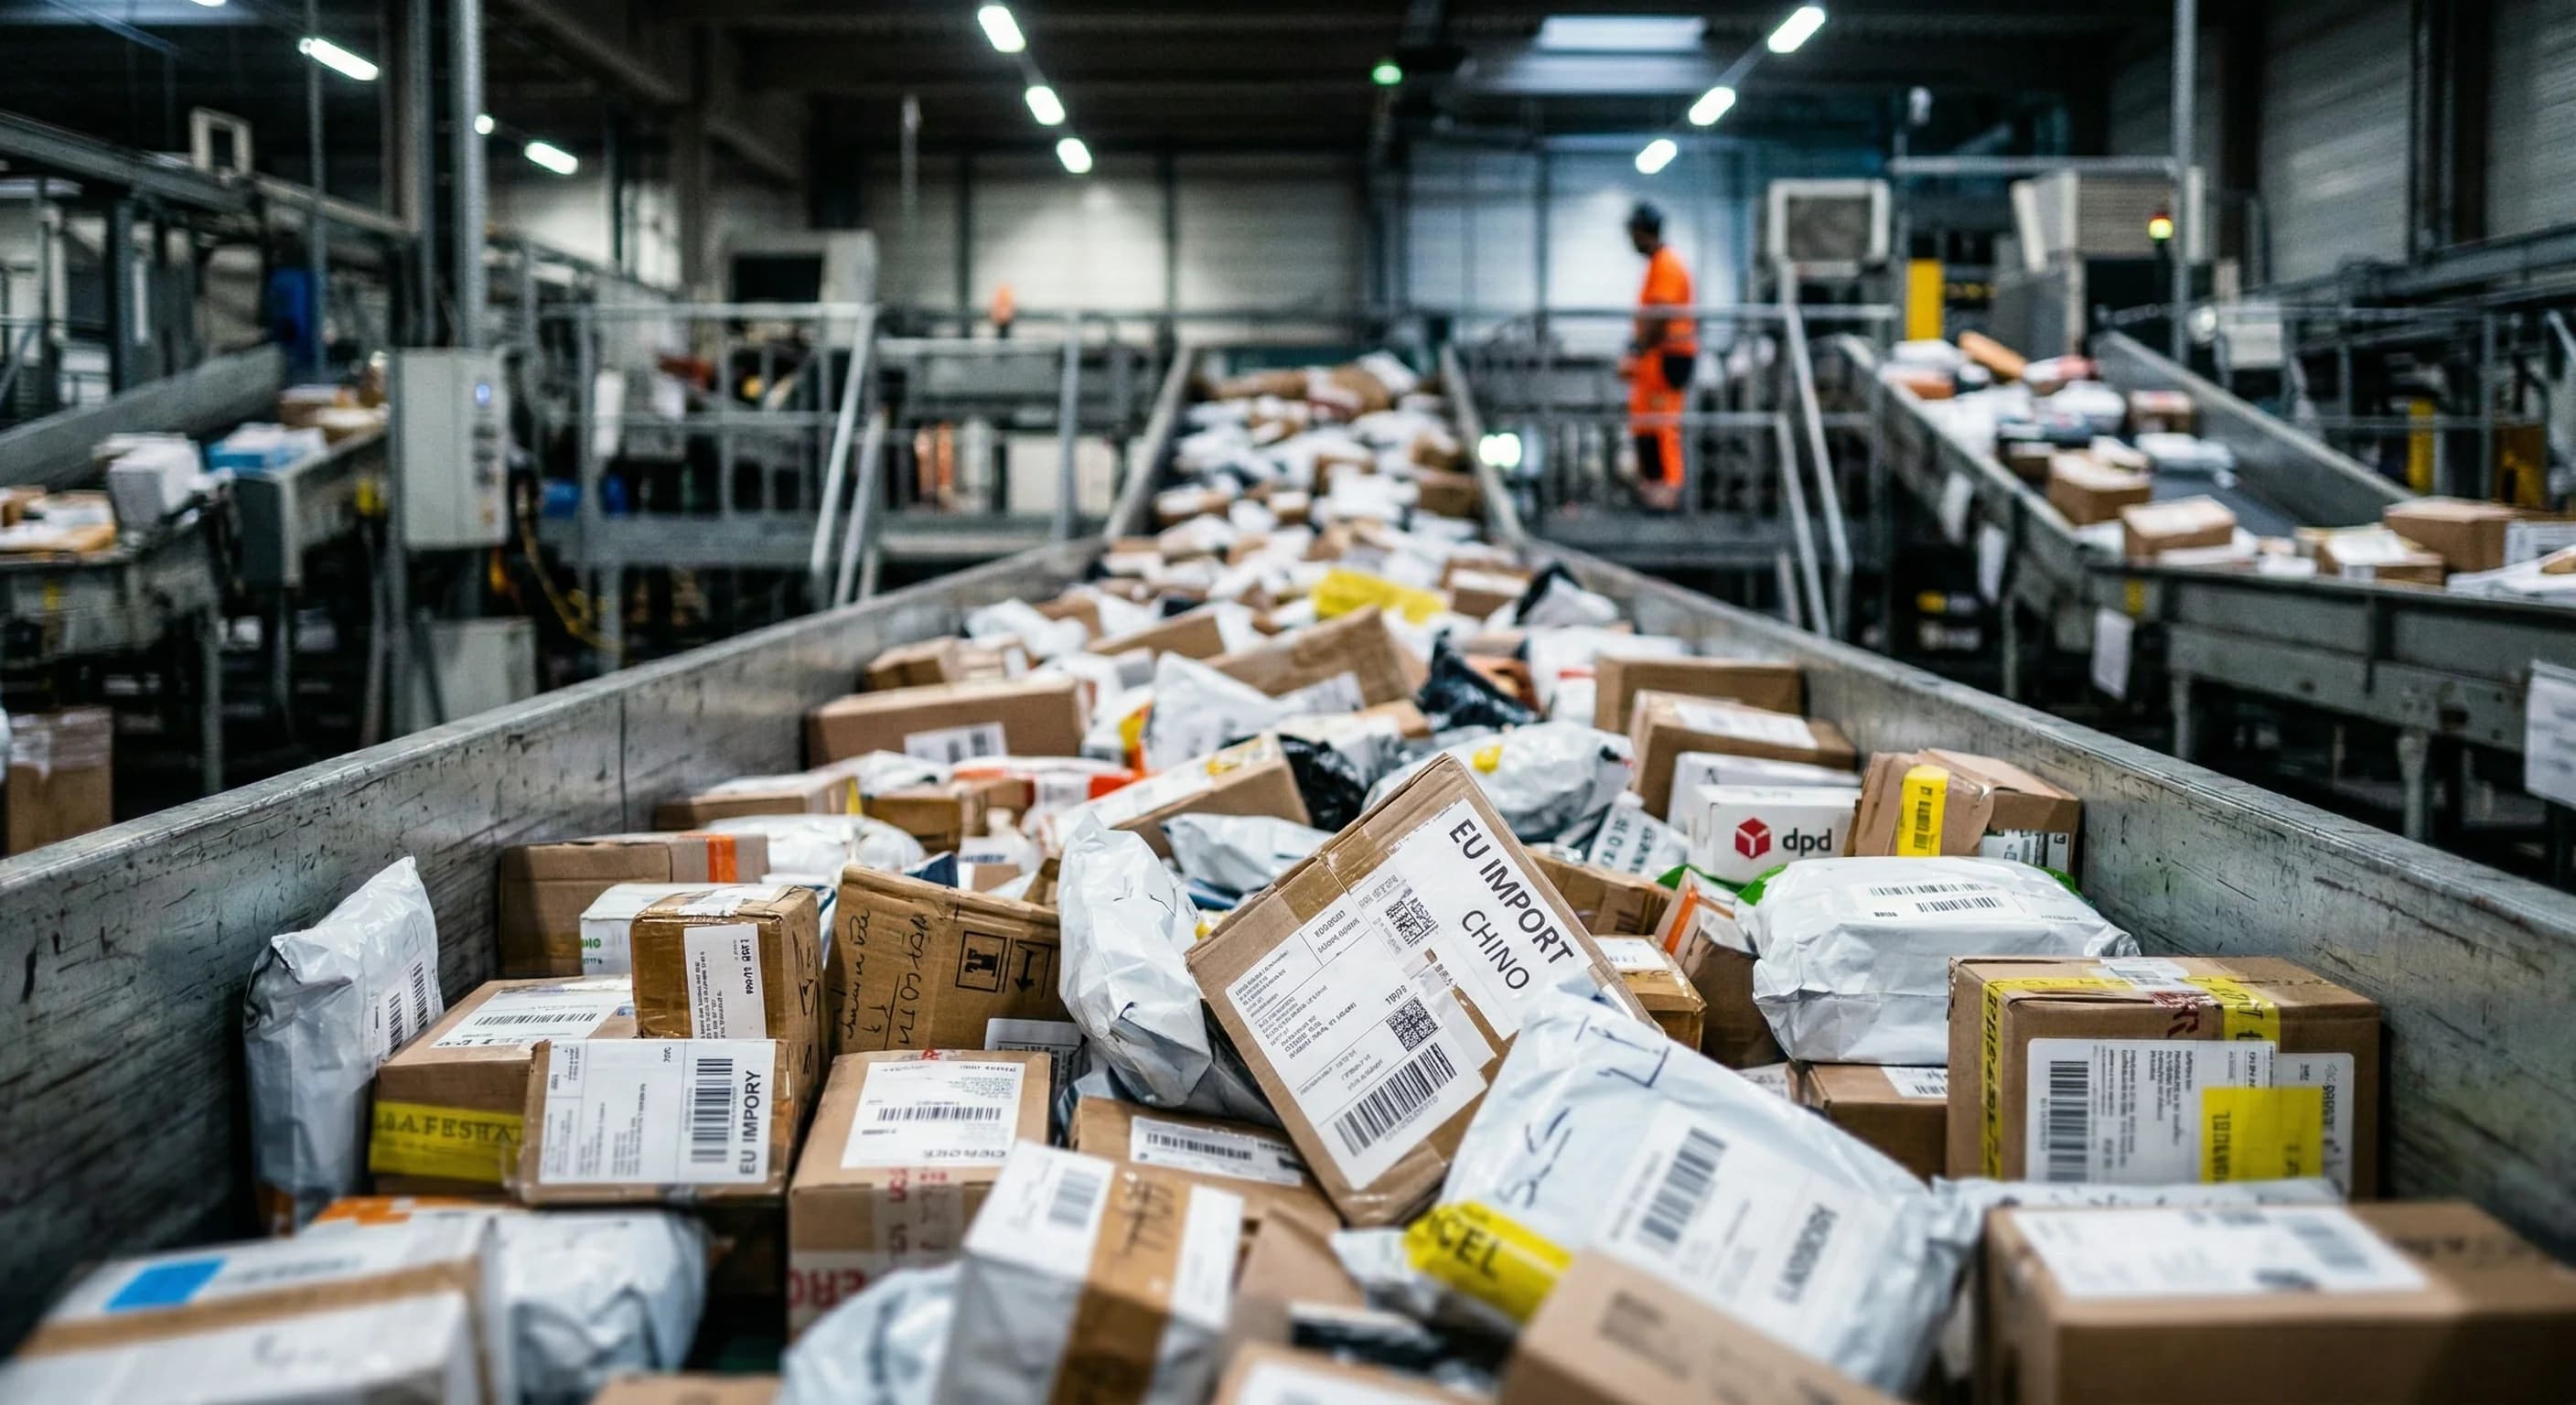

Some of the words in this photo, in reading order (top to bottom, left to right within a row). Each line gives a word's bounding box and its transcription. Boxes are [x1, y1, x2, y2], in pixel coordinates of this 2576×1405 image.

[1782, 827, 1832, 856] dpd
[1449, 819, 1490, 859] EU
[1479, 858, 1574, 963] IMPORT
[1462, 910, 1530, 989] CHINO
[742, 1070, 761, 1142] IMPORY
[739, 1150, 757, 1174] EU
